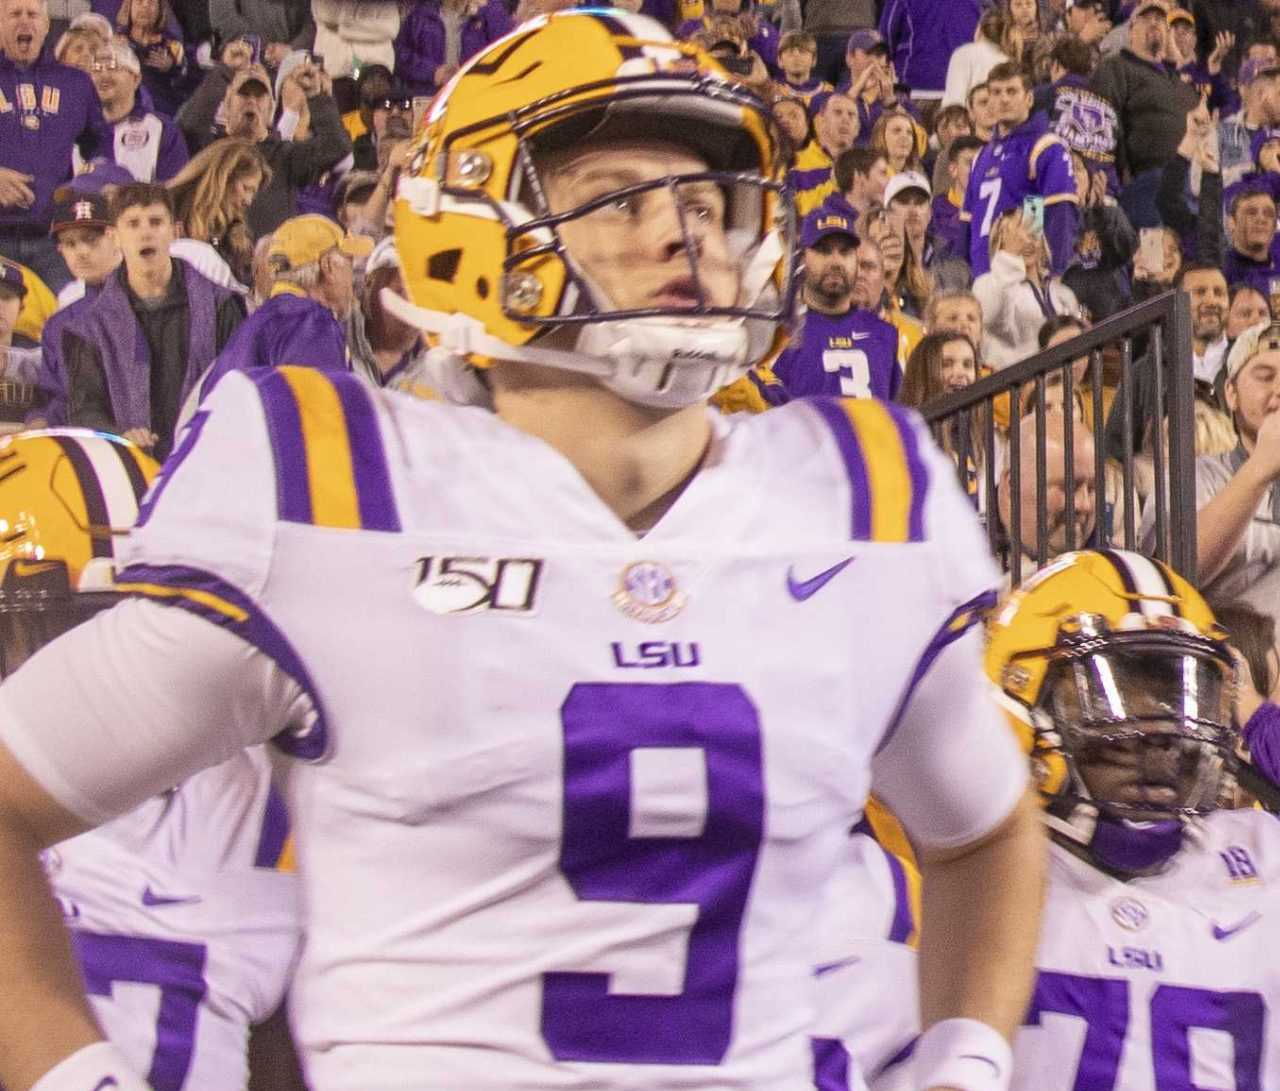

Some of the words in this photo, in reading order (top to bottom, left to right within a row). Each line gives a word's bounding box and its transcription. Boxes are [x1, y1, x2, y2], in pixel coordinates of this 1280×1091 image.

[817, 215, 848, 231] LSU
[979, 178, 1003, 238] 7
[822, 349, 873, 400] 3
[416, 556, 544, 613] 150
[610, 641, 701, 669] LSU
[540, 680, 768, 1067] 9
[1107, 944, 1165, 972] LSU
